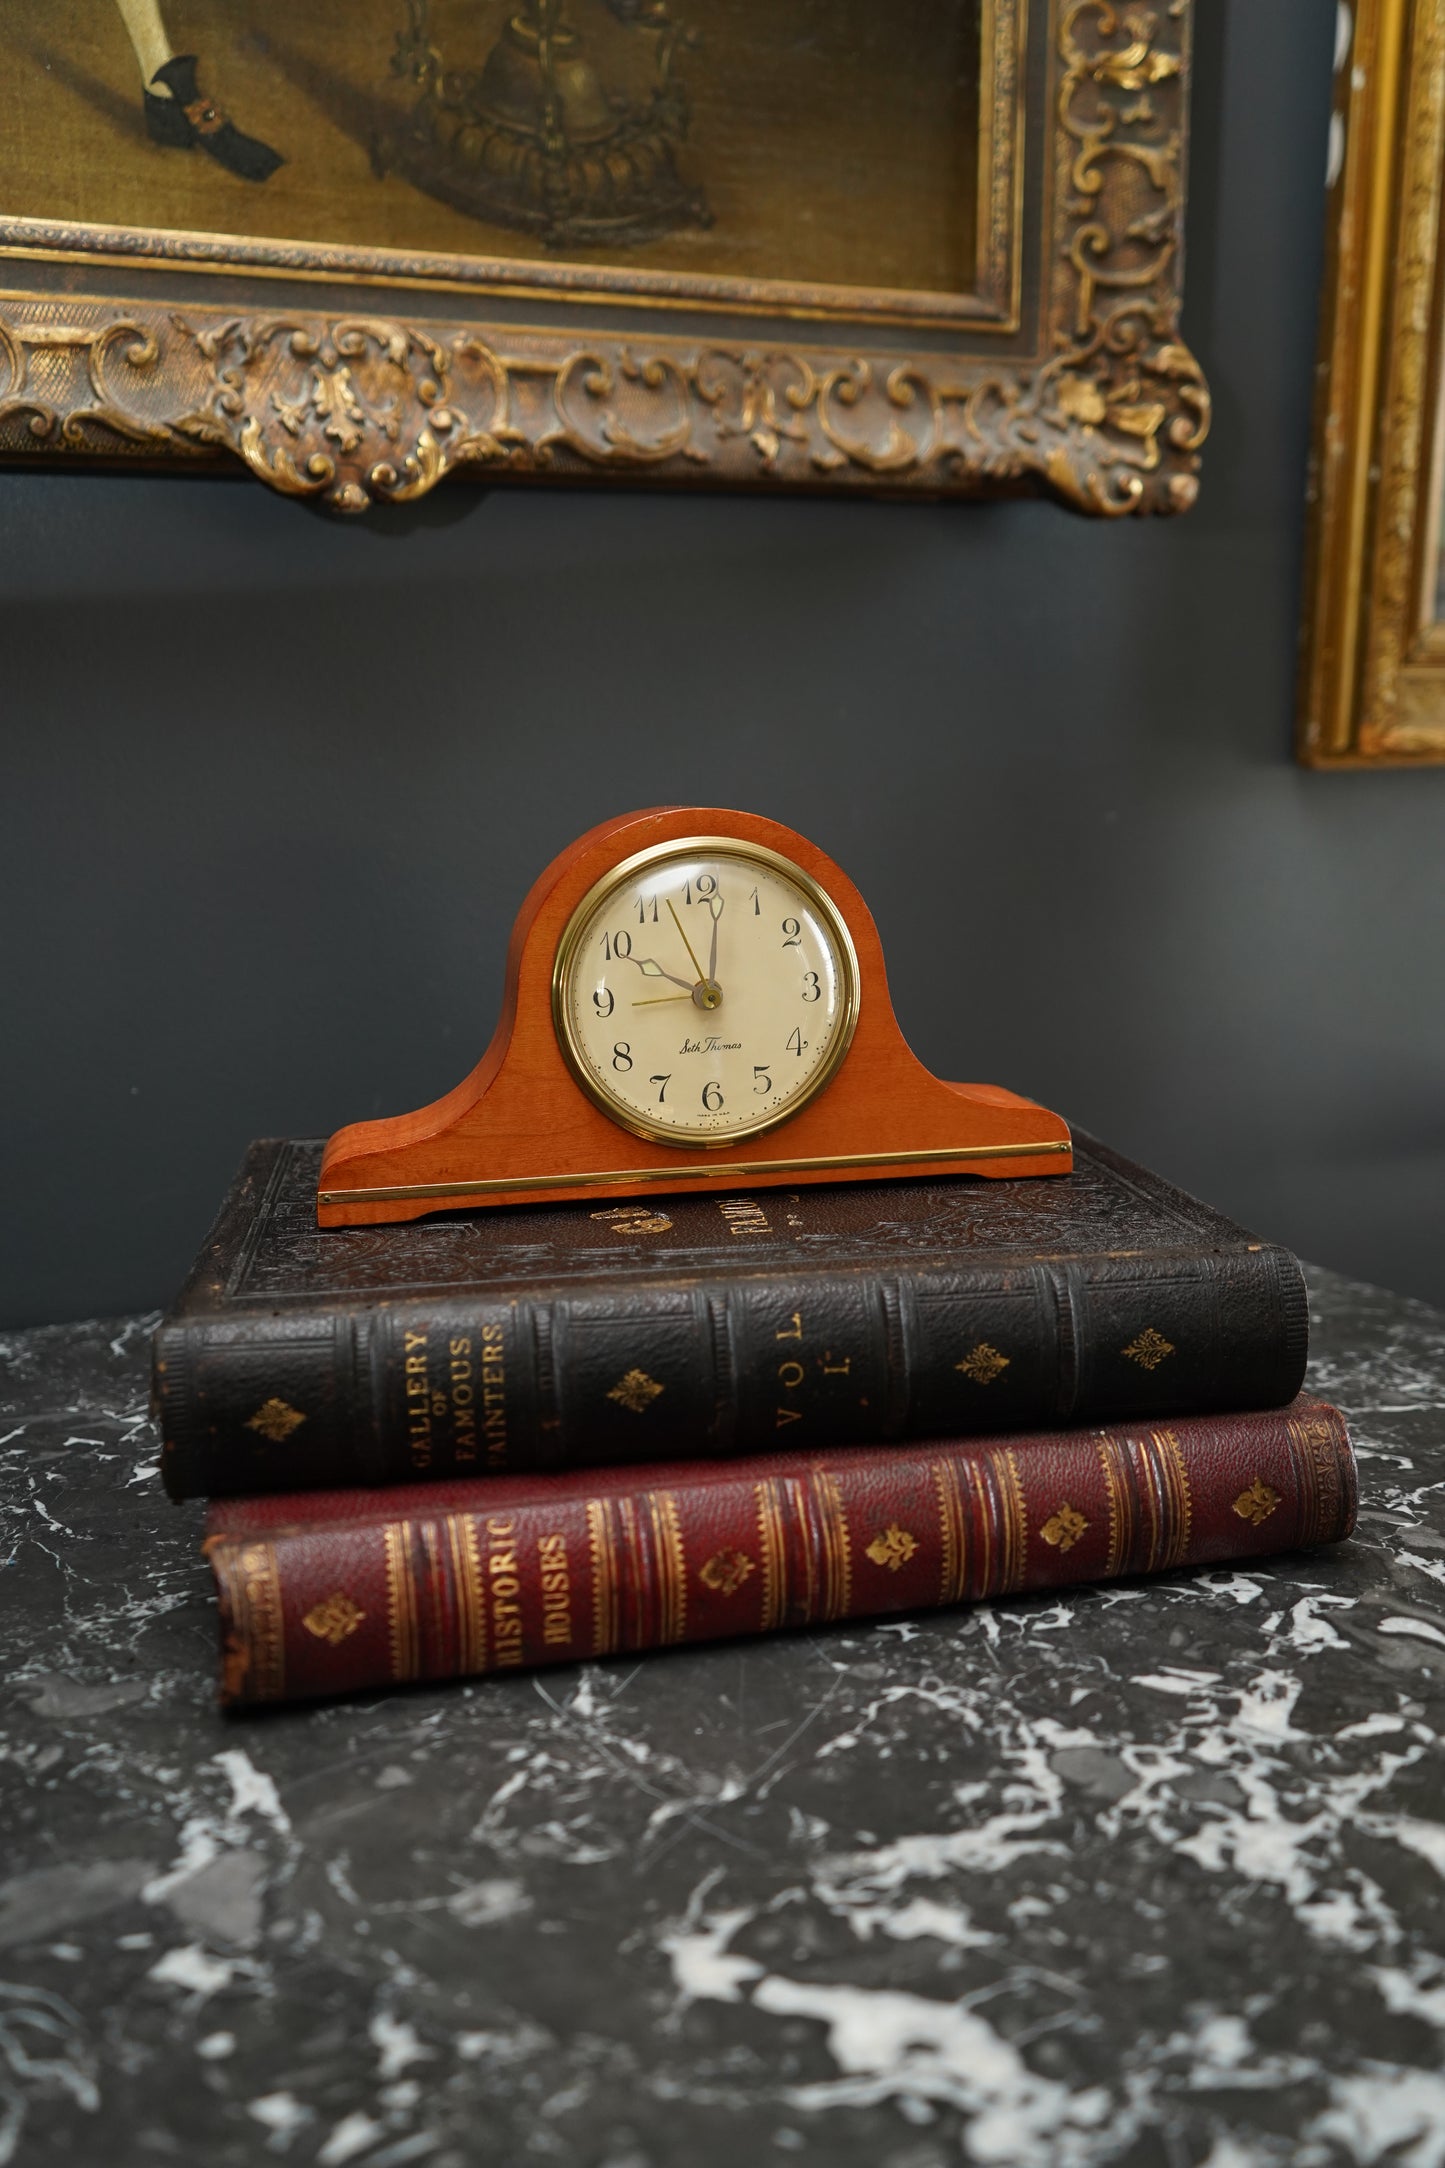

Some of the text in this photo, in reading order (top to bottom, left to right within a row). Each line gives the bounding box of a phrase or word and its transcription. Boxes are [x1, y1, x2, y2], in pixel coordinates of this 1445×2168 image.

[681, 875, 716, 905] 12
[749, 887, 761, 915] 1
[634, 894, 659, 923] 11
[600, 930, 632, 960] 10
[782, 918, 801, 948] 2
[802, 972, 821, 1002] 3
[593, 987, 615, 1018] 9
[679, 1037, 742, 1054] Seth Thomas
[786, 1027, 808, 1056] 4
[612, 1042, 633, 1072] 8
[650, 1074, 672, 1102] 7
[753, 1066, 772, 1094] 5
[702, 1081, 724, 1111] 6
[404, 1330, 431, 1468] GALLERY
[432, 1391, 447, 1416] OF
[450, 1337, 476, 1461] FAMOUS
[482, 1324, 506, 1466] PAINTERS
[486, 1518, 523, 1666] HISTORIC
[537, 1533, 572, 1645] HOUSES
